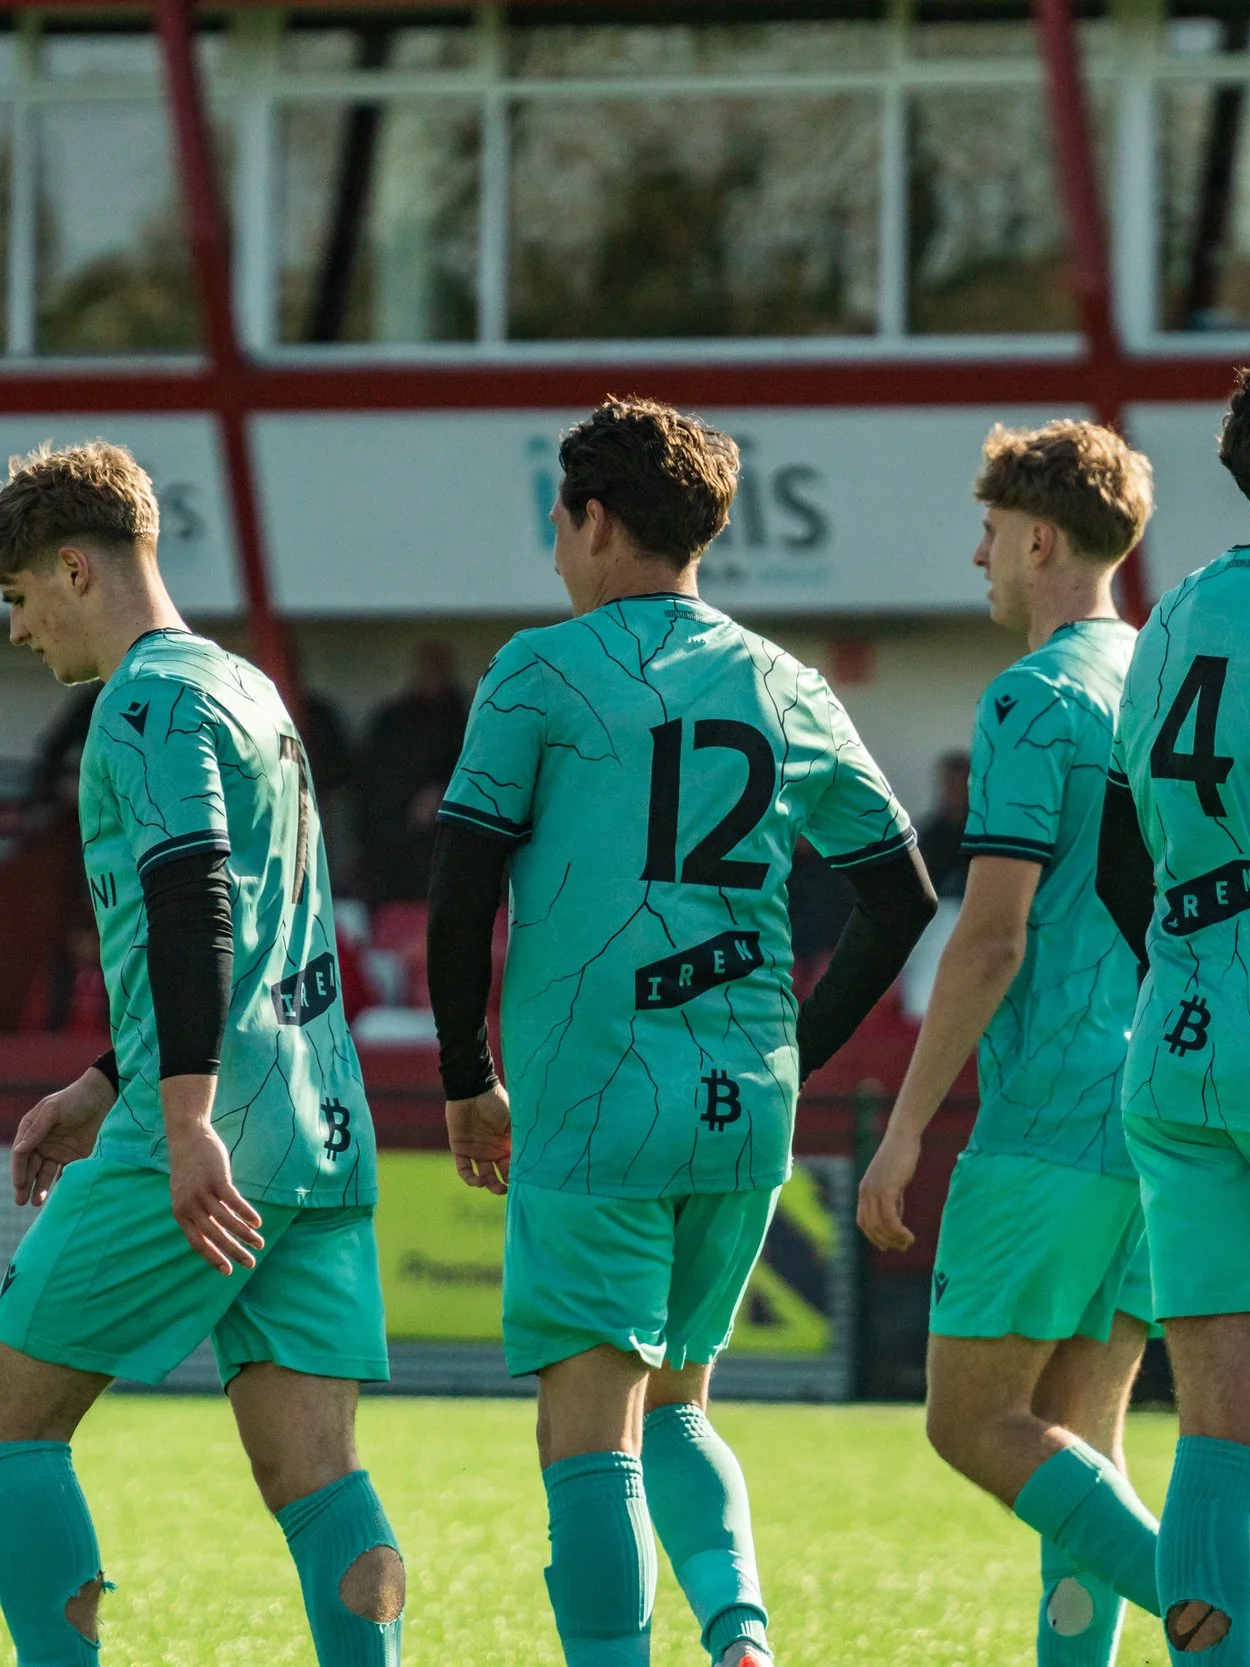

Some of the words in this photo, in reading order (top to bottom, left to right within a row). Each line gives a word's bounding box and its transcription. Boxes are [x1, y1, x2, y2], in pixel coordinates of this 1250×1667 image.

[528, 434, 829, 553] iis
[638, 717, 776, 891] 12
[1150, 654, 1234, 818] 4
[647, 939, 753, 1001] IREN
